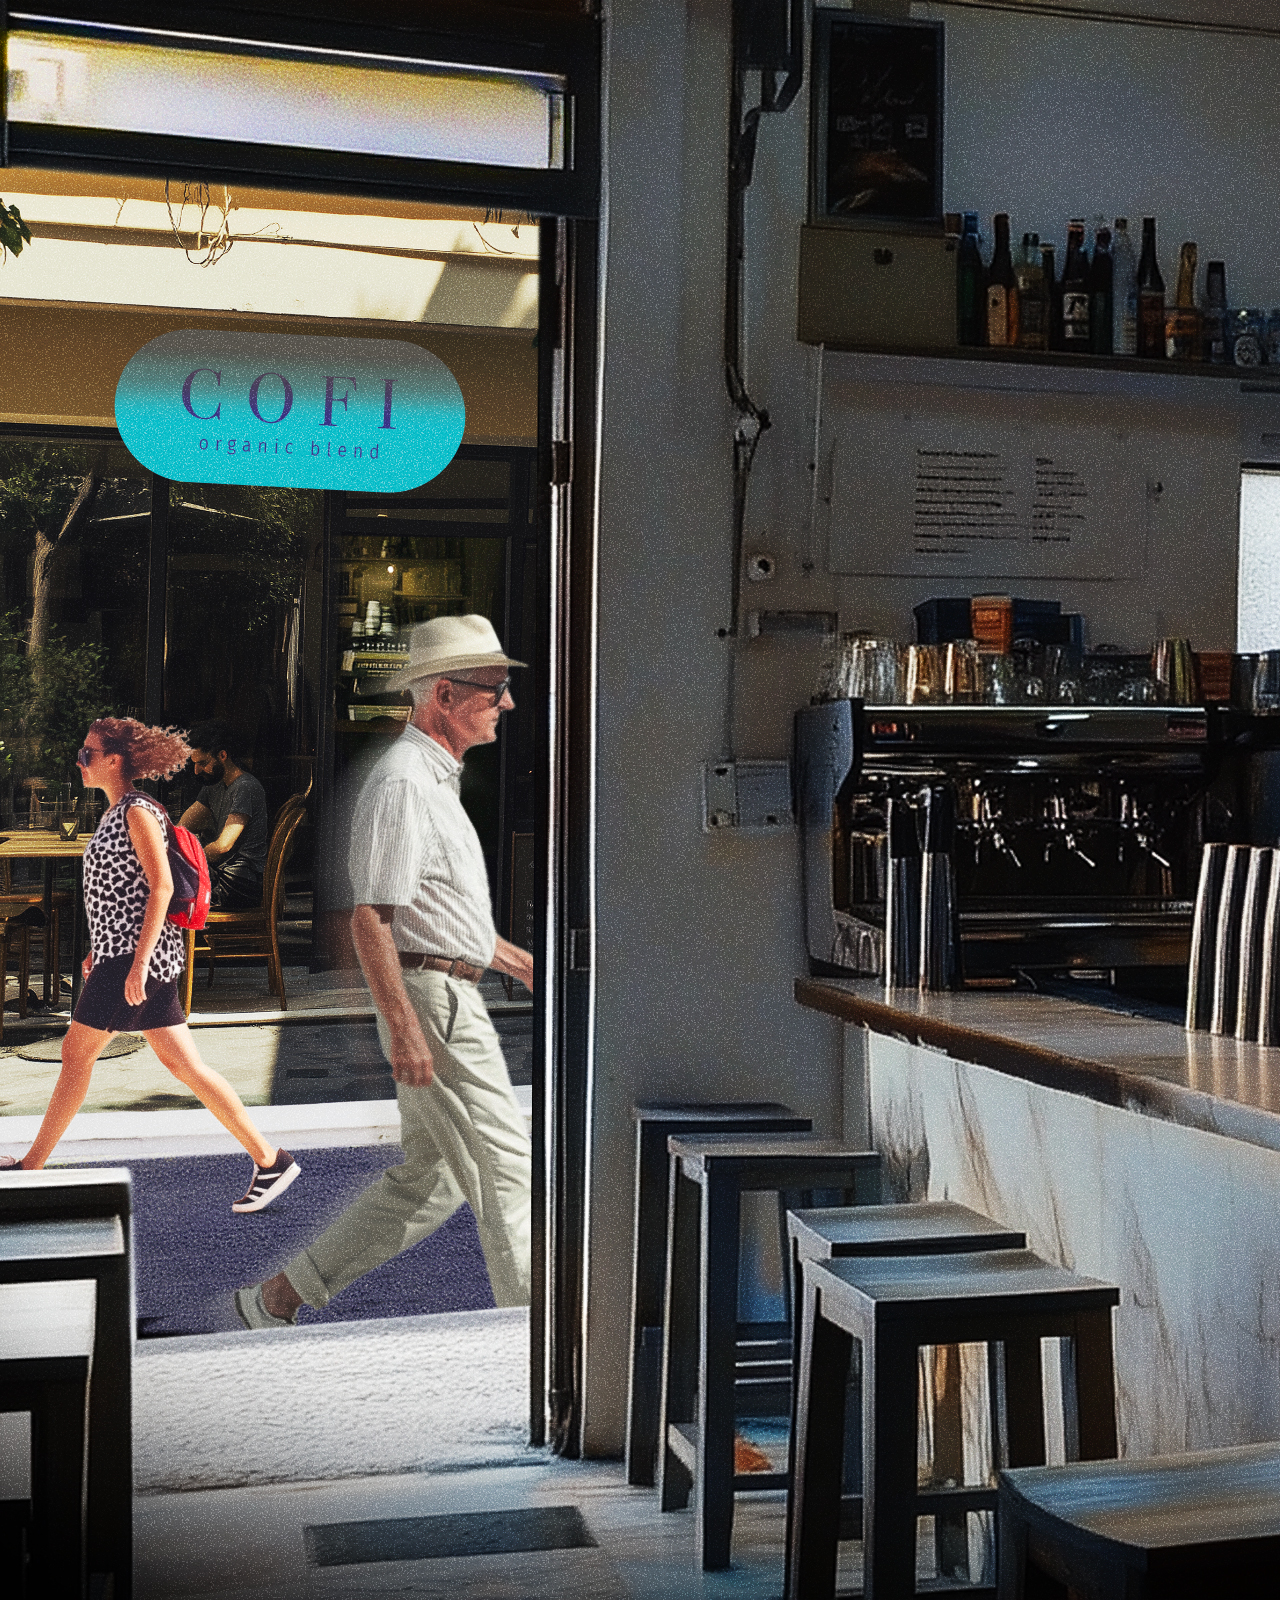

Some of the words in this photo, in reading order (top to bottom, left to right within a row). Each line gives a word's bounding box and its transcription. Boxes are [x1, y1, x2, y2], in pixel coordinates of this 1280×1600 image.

[182, 368, 399, 430] COFI
[199, 438, 294, 455] organic
[310, 440, 380, 460] blend
